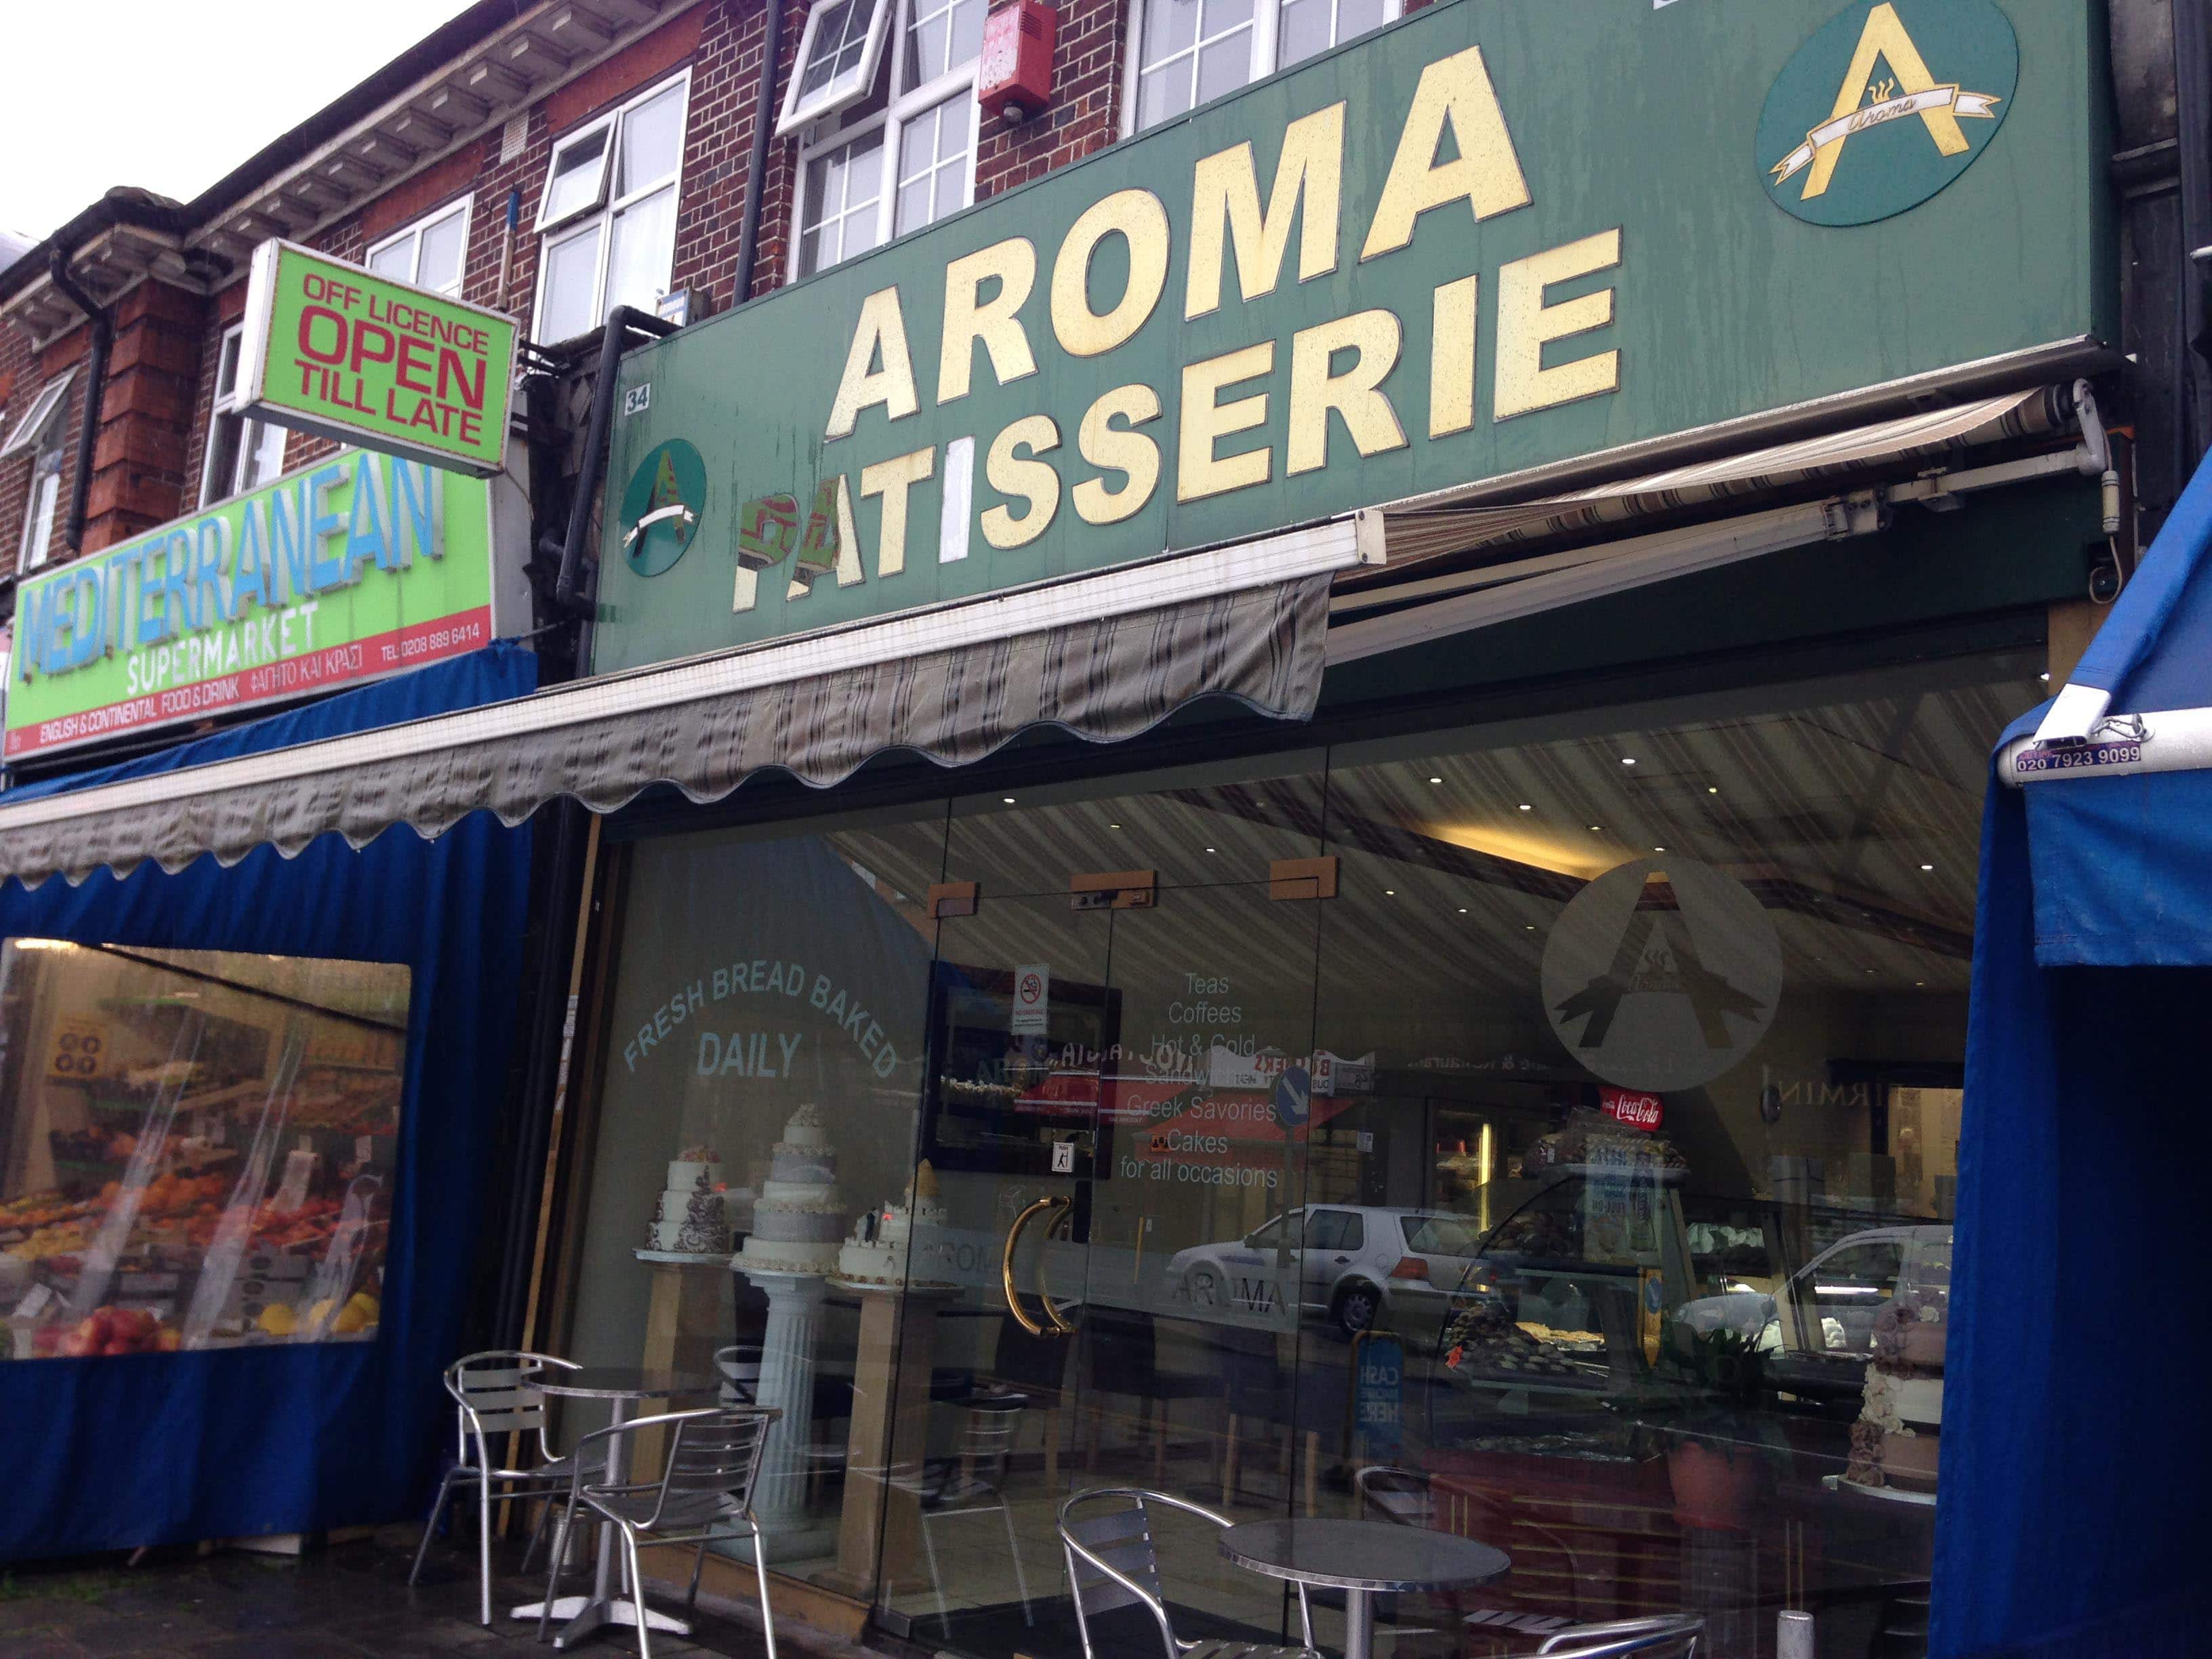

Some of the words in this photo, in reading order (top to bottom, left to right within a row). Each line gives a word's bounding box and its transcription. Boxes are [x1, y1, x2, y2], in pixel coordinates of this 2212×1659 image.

[824, 45, 1532, 442] AROMA
[304, 273, 362, 310] OFF
[369, 294, 489, 356] LICENCE
[298, 304, 487, 410] OPEN
[294, 359, 377, 415] TILL
[386, 388, 483, 446] LATE
[628, 387, 648, 412] 34
[732, 227, 1622, 613] PATISSERIE
[18, 453, 441, 681] MEDITERRANEAN
[127, 602, 318, 696] SUPERMARKET
[401, 637, 428, 657] 0208
[430, 631, 450, 651] 889
[451, 623, 480, 644] 6414
[40, 720, 79, 744] ENGLISH
[79, 718, 87, 732] &
[88, 697, 157, 731] CONTINENTAL
[160, 687, 192, 713] FOOD
[192, 686, 201, 708] &
[203, 678, 239, 704] DRINK
[2018, 758, 2047, 771] 020
[2052, 751, 2093, 768] 7923
[2098, 747, 2140, 764] 9099
[1185, 972, 1229, 994] Teas
[623, 980, 705, 1073] FRESH
[712, 960, 805, 1002] BREAD
[810, 975, 898, 1079] BAKED
[1168, 1002, 1242, 1024] Coffees
[697, 1031, 802, 1078] DAILY
[1152, 1034, 1185, 1053] Hot
[1190, 1033, 1202, 1056] &
[1210, 1033, 1256, 1057] Cold
[1127, 1094, 1183, 1118] Greek
[1190, 1097, 1277, 1122] Savories
[1167, 1127, 1228, 1153] Cakes
[1120, 1155, 1145, 1179] for
[1151, 1158, 1171, 1181] all
[1178, 1162, 1277, 1189] occasions
